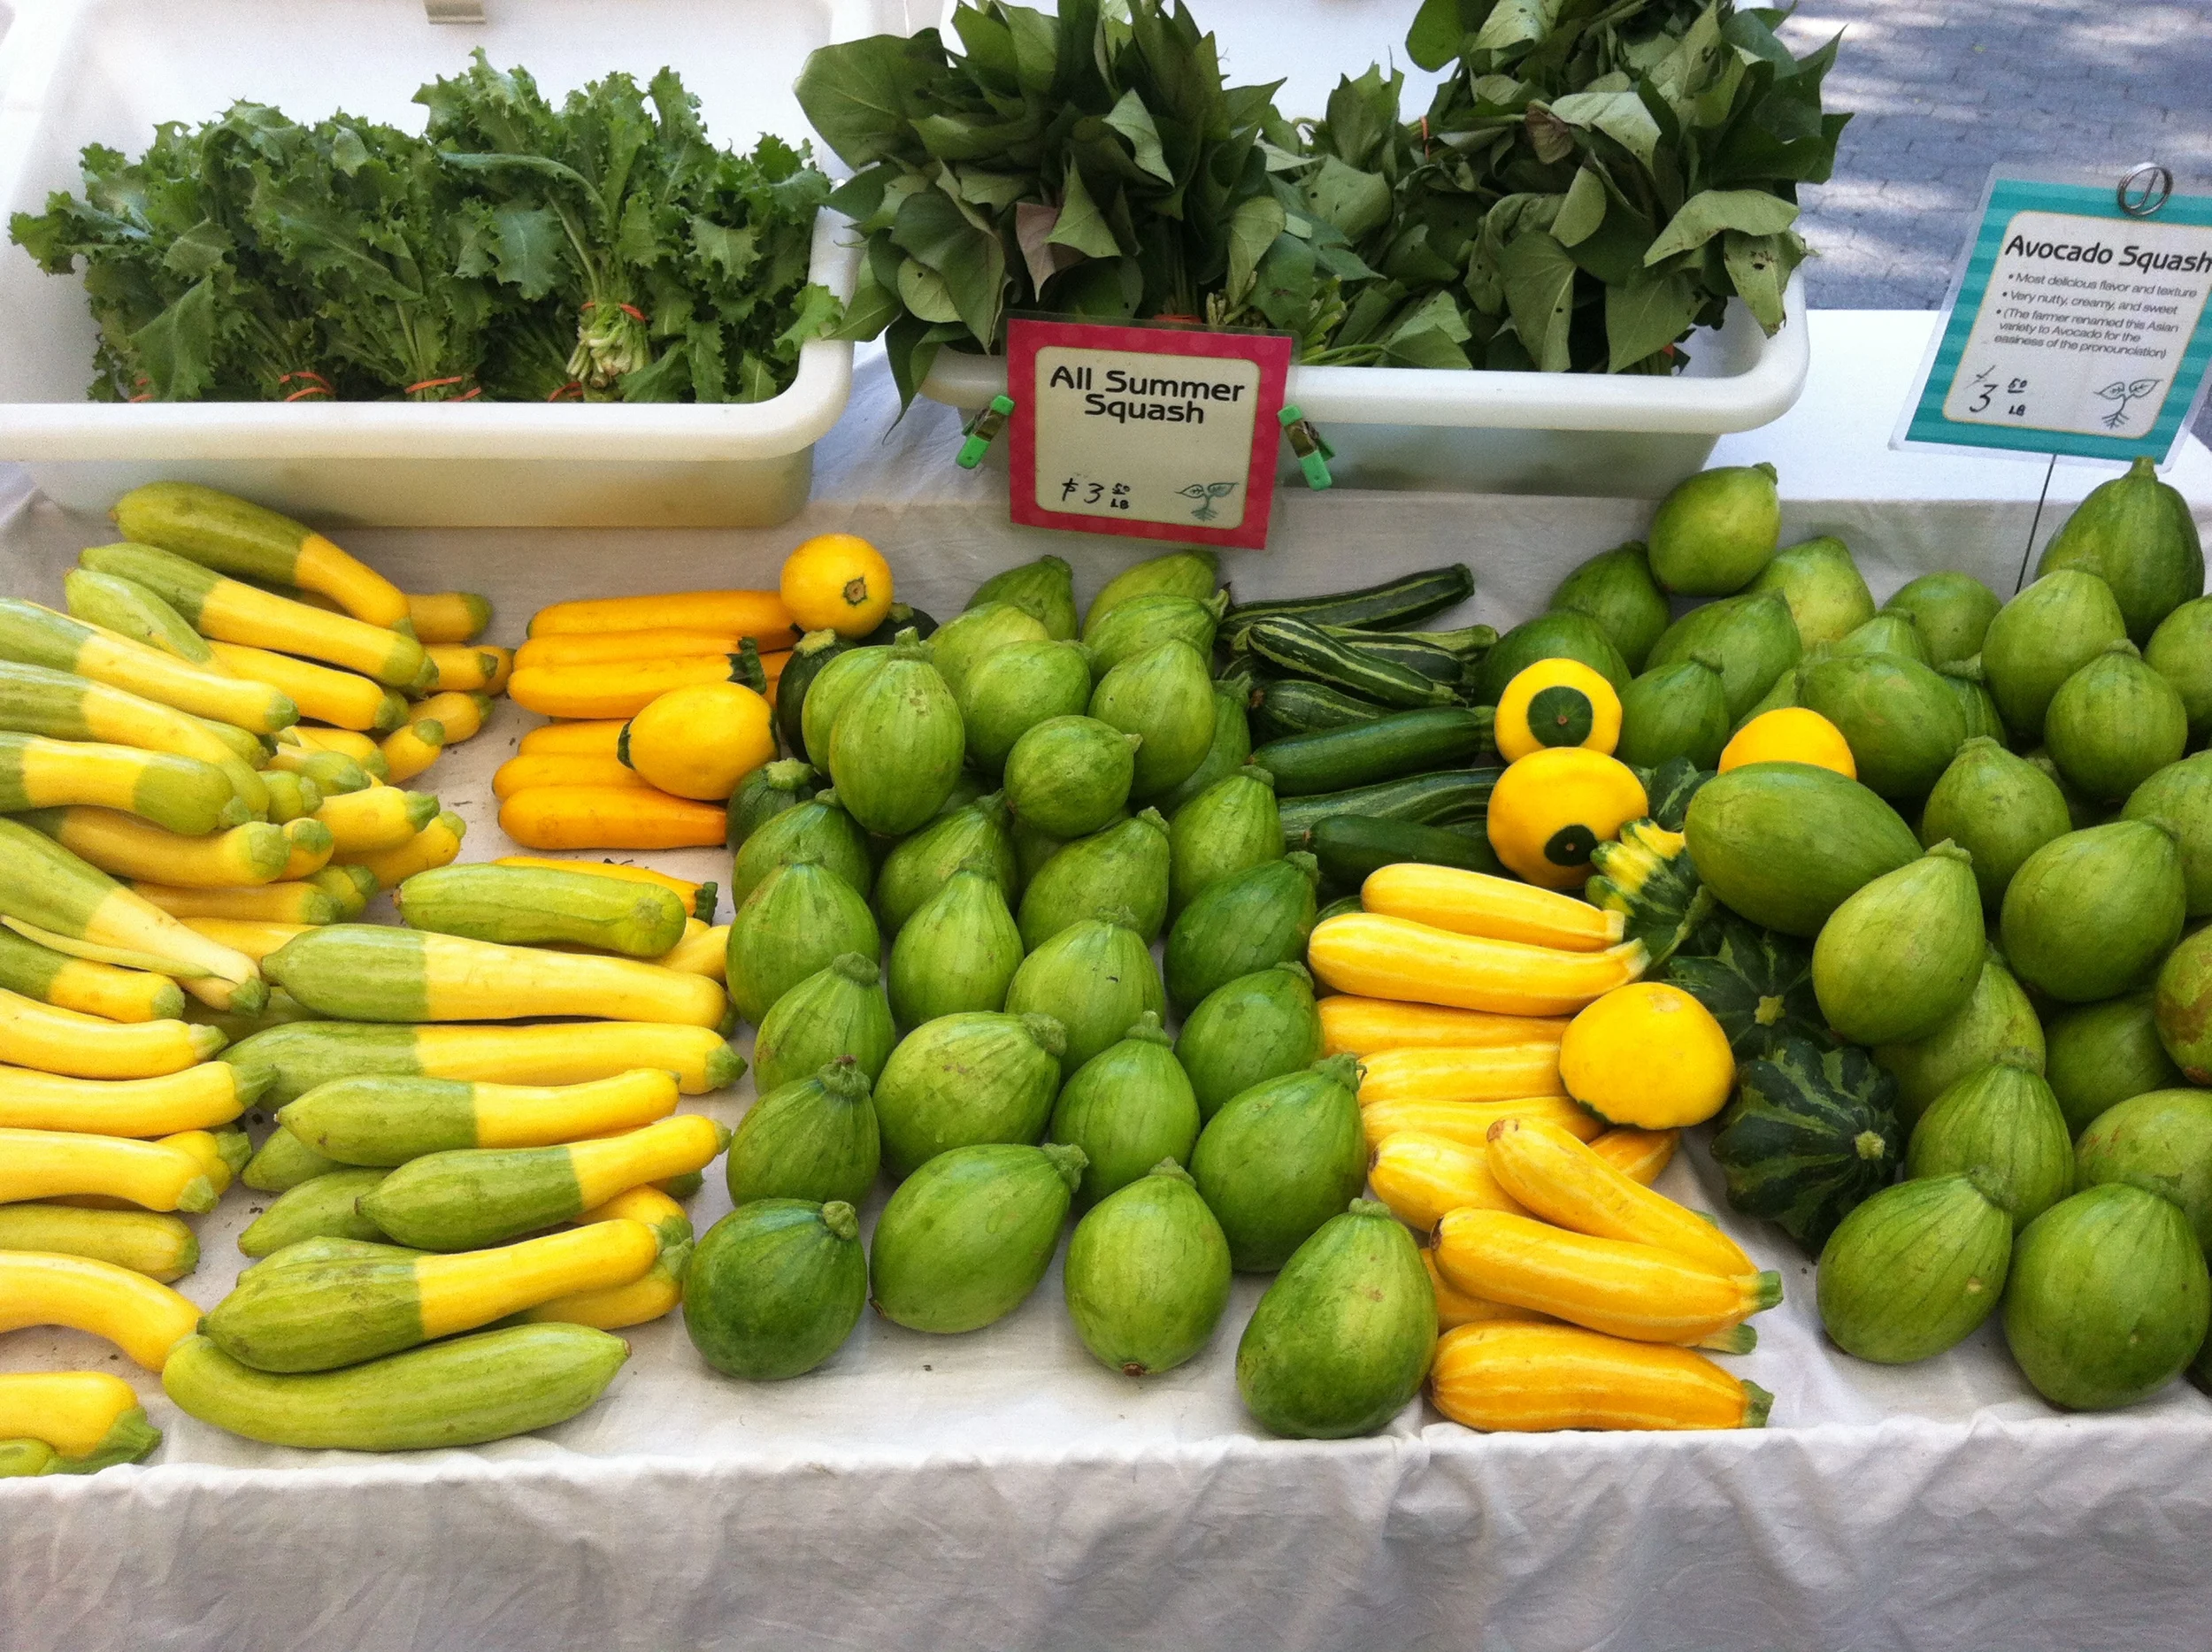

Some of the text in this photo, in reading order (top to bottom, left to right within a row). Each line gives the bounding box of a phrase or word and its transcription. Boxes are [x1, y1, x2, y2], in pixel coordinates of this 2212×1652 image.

[2005, 234, 2212, 274] Avocado Squash
[2016, 273, 2198, 297] Most delicious flavor and texture
[2011, 290, 2036, 304] Very
[2118, 303, 2142, 311] and
[2142, 304, 2178, 315] sweet
[2000, 321, 2141, 342] variety to Avocado for the
[2004, 308, 2179, 333] (The farmer renamed this Asian
[1994, 335, 2044, 347] easiness
[2046, 339, 2059, 348] of
[2060, 340, 2078, 350] the
[1050, 365, 1245, 402] All Summer
[1085, 393, 1204, 424] Squash
